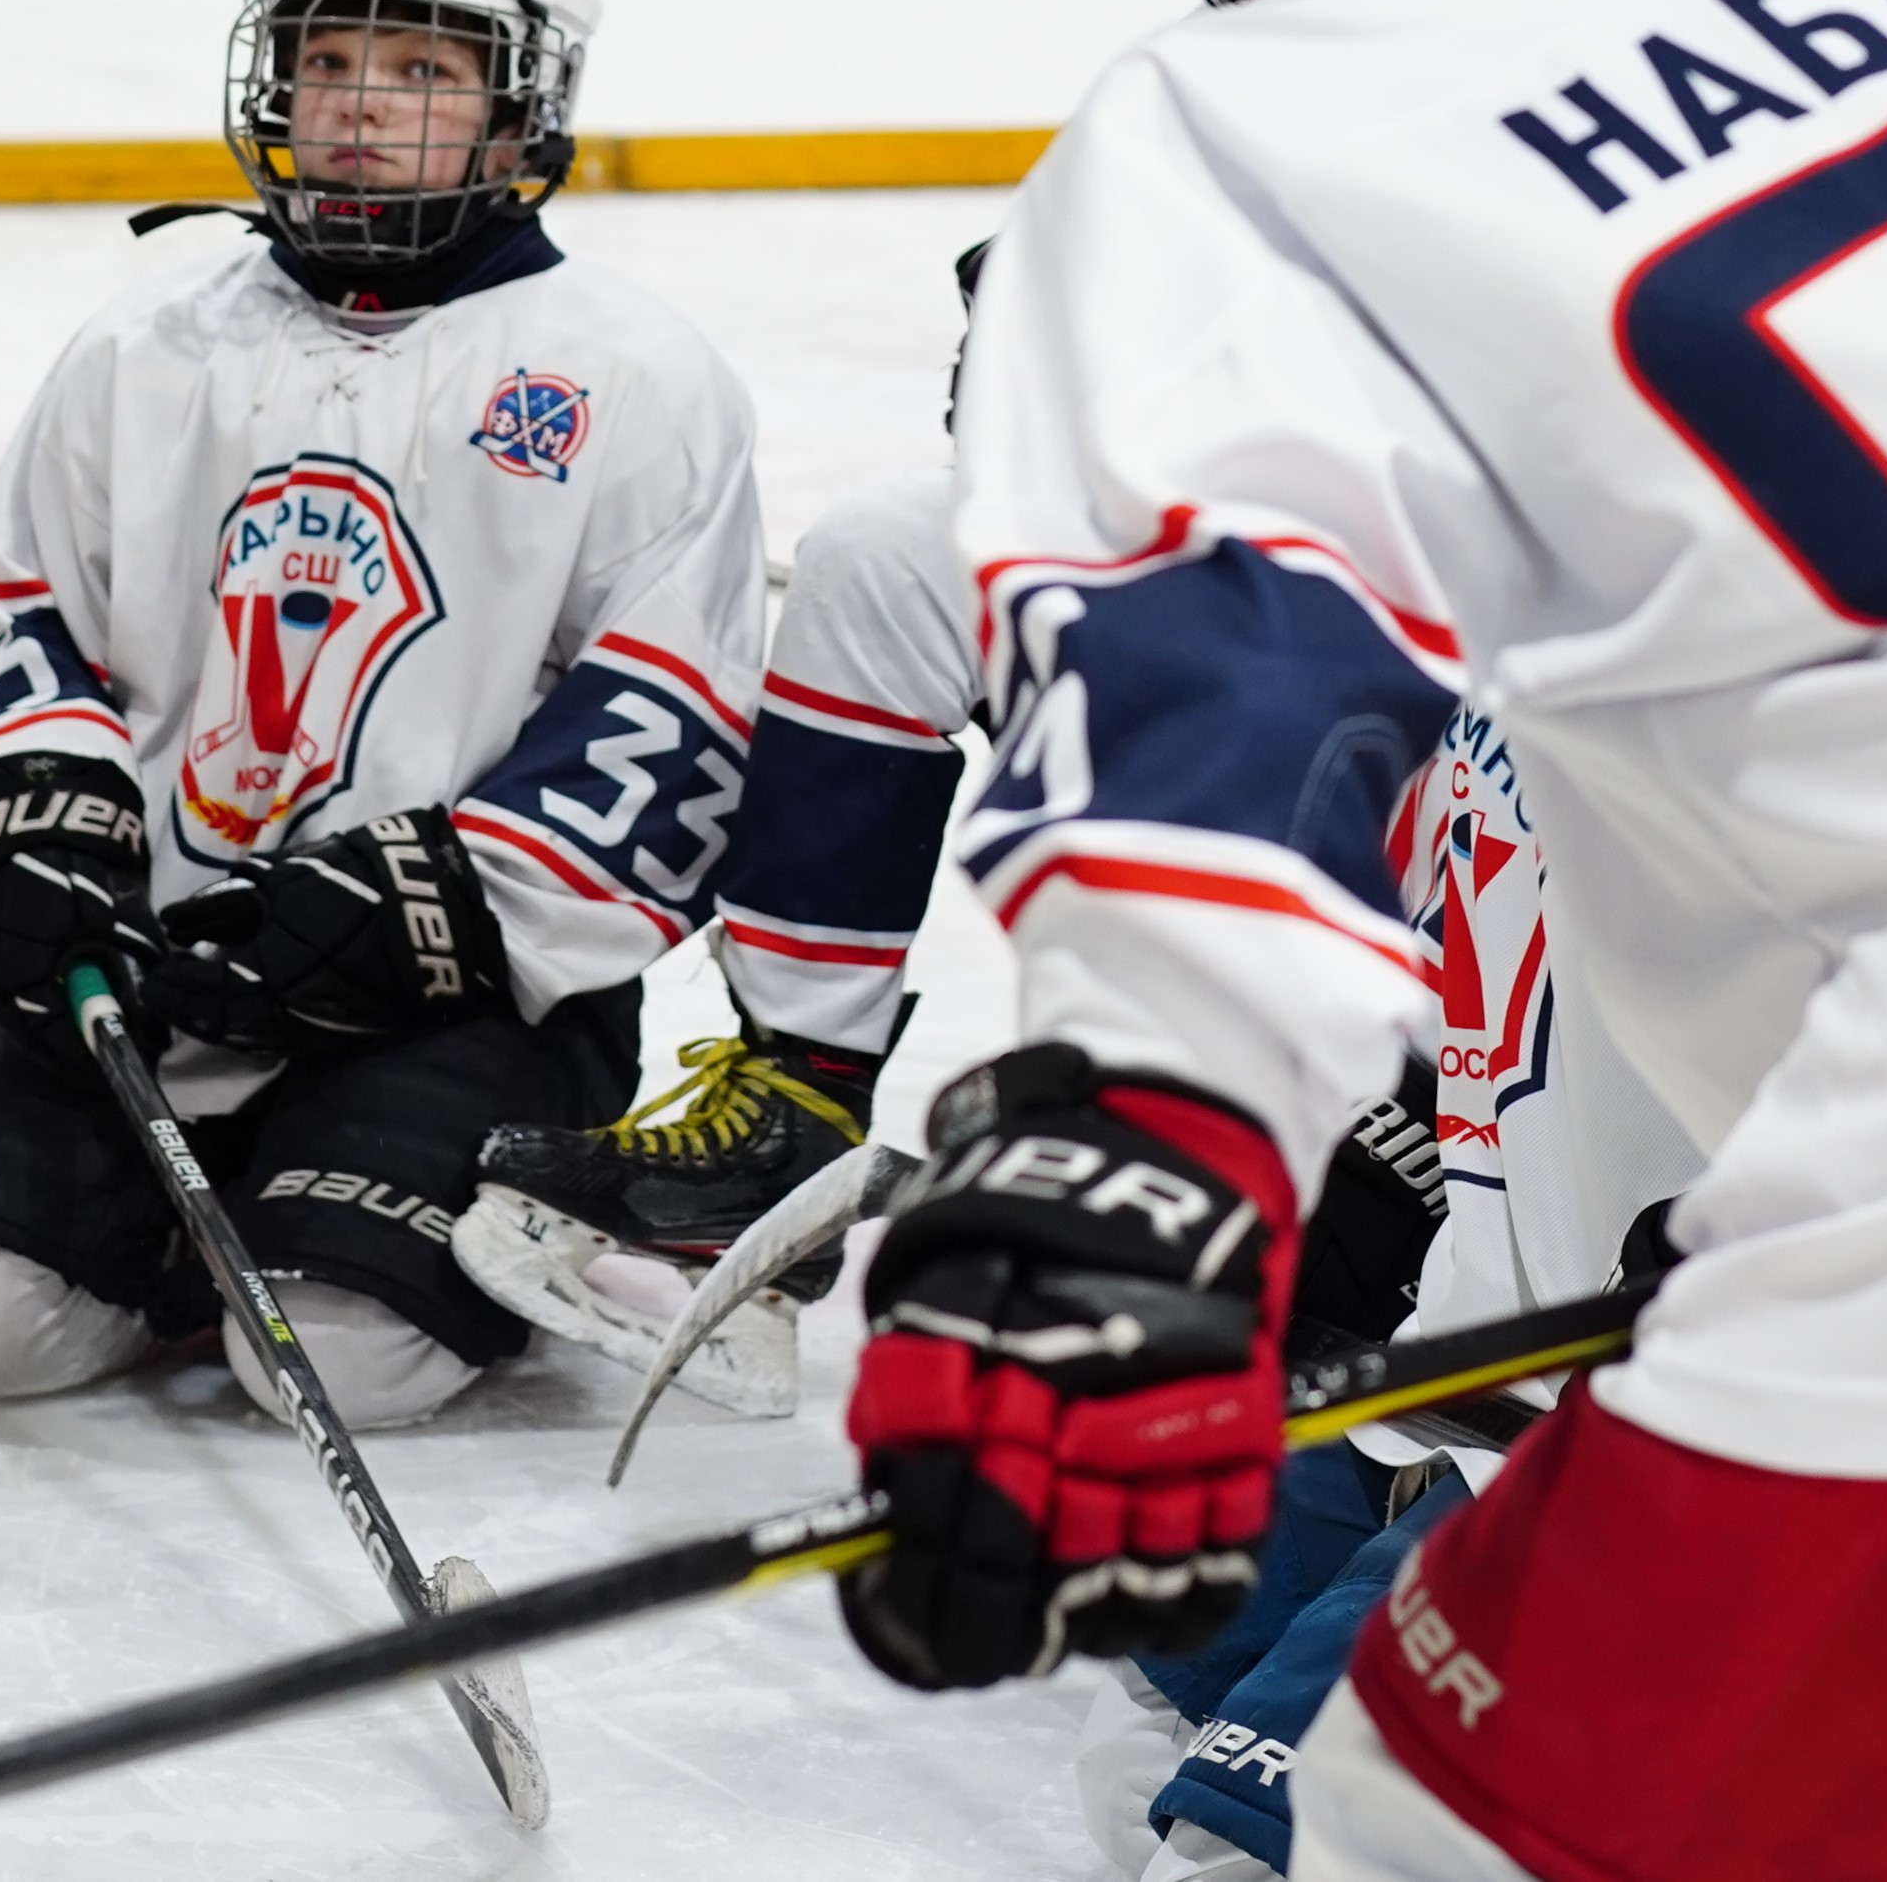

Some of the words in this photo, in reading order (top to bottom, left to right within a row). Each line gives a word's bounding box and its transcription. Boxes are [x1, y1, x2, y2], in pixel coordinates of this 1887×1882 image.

[318, 200, 385, 216] CCM
[282, 551, 341, 585] СШ
[539, 690, 745, 902] 33
[365, 814, 465, 1000] AUER
[148, 1118, 210, 1191] BAUER
[258, 1168, 454, 1245] BAUE
